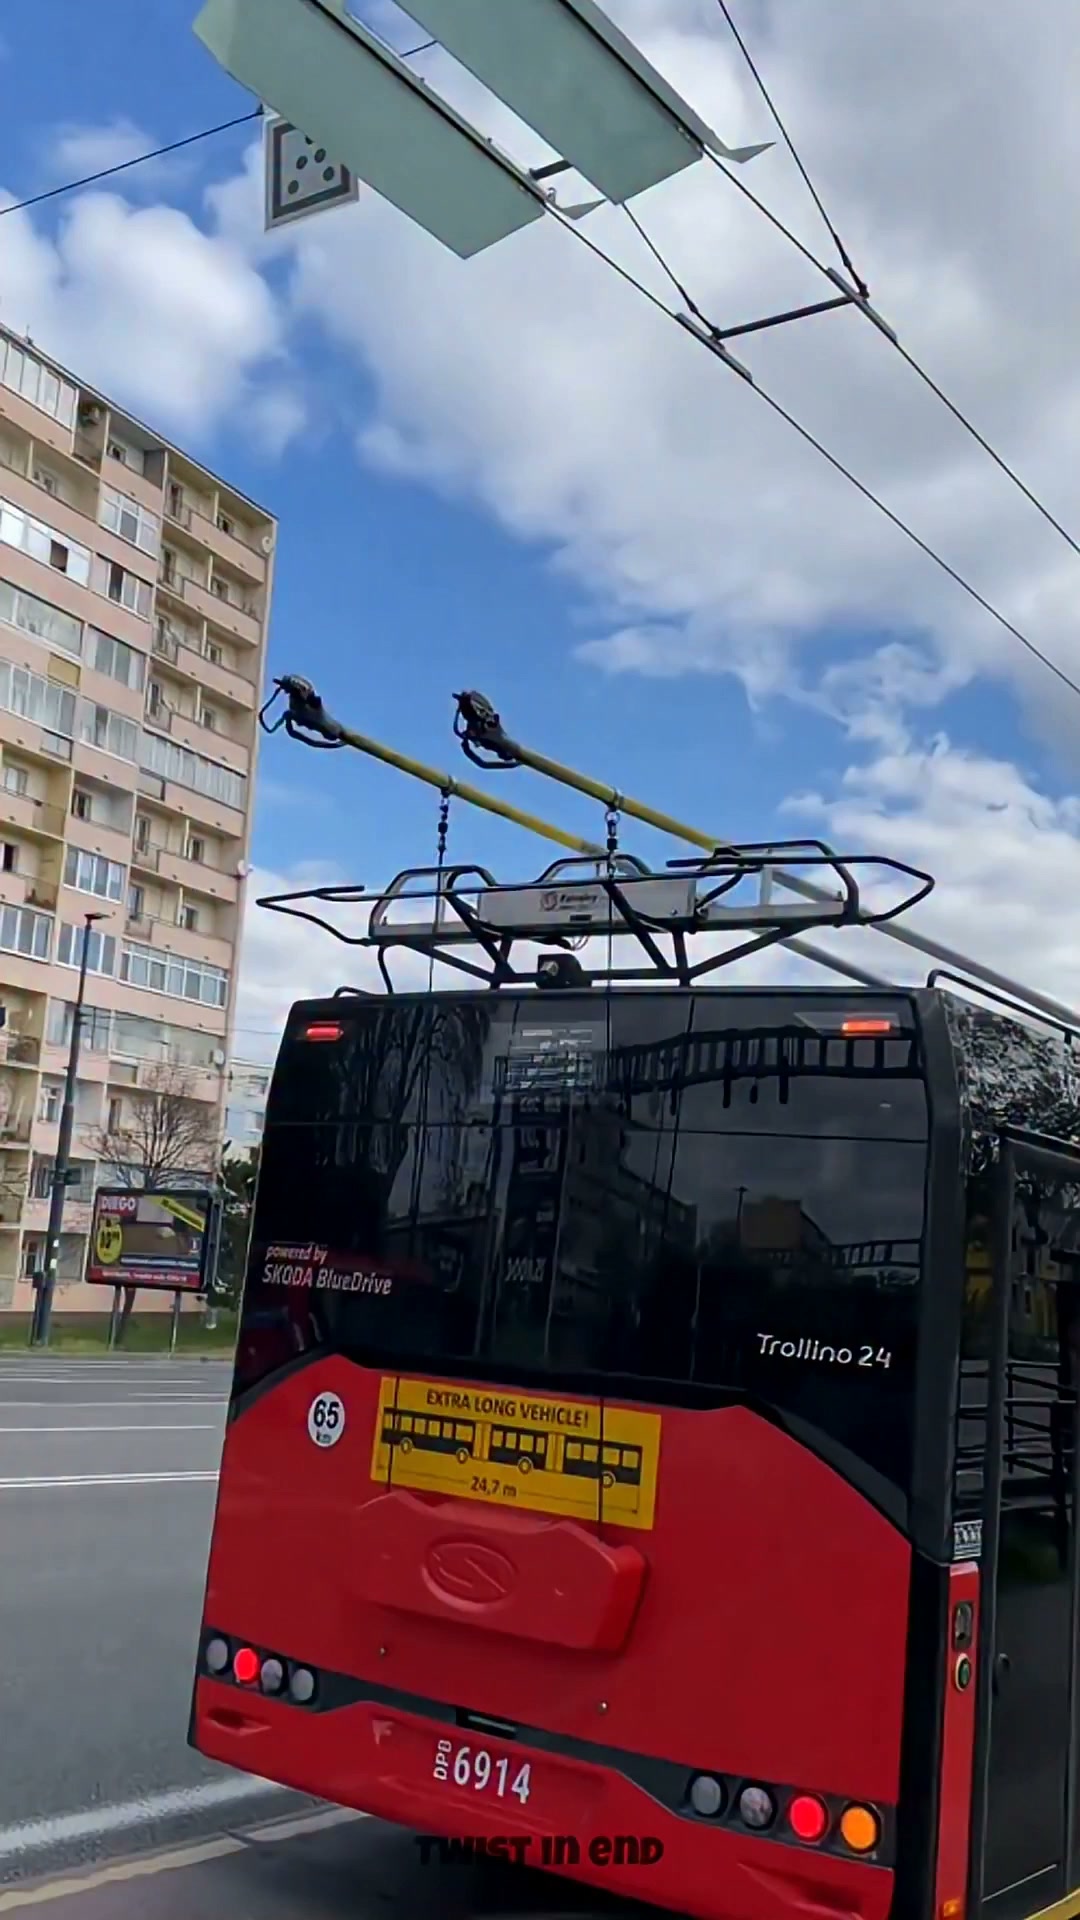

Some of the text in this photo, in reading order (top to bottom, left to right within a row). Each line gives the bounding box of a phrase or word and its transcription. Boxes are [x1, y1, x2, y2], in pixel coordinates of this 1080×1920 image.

[264, 1242, 328, 1265] powered by
[316, 1268, 392, 1295] BlueDrive
[757, 1333, 892, 1369] Trollino 24
[314, 1399, 340, 1429] 65
[426, 1388, 589, 1429] EXTRA LONG VEHICLE!
[470, 1475, 517, 1498] 24,7 m
[454, 1746, 531, 1804] 6914
